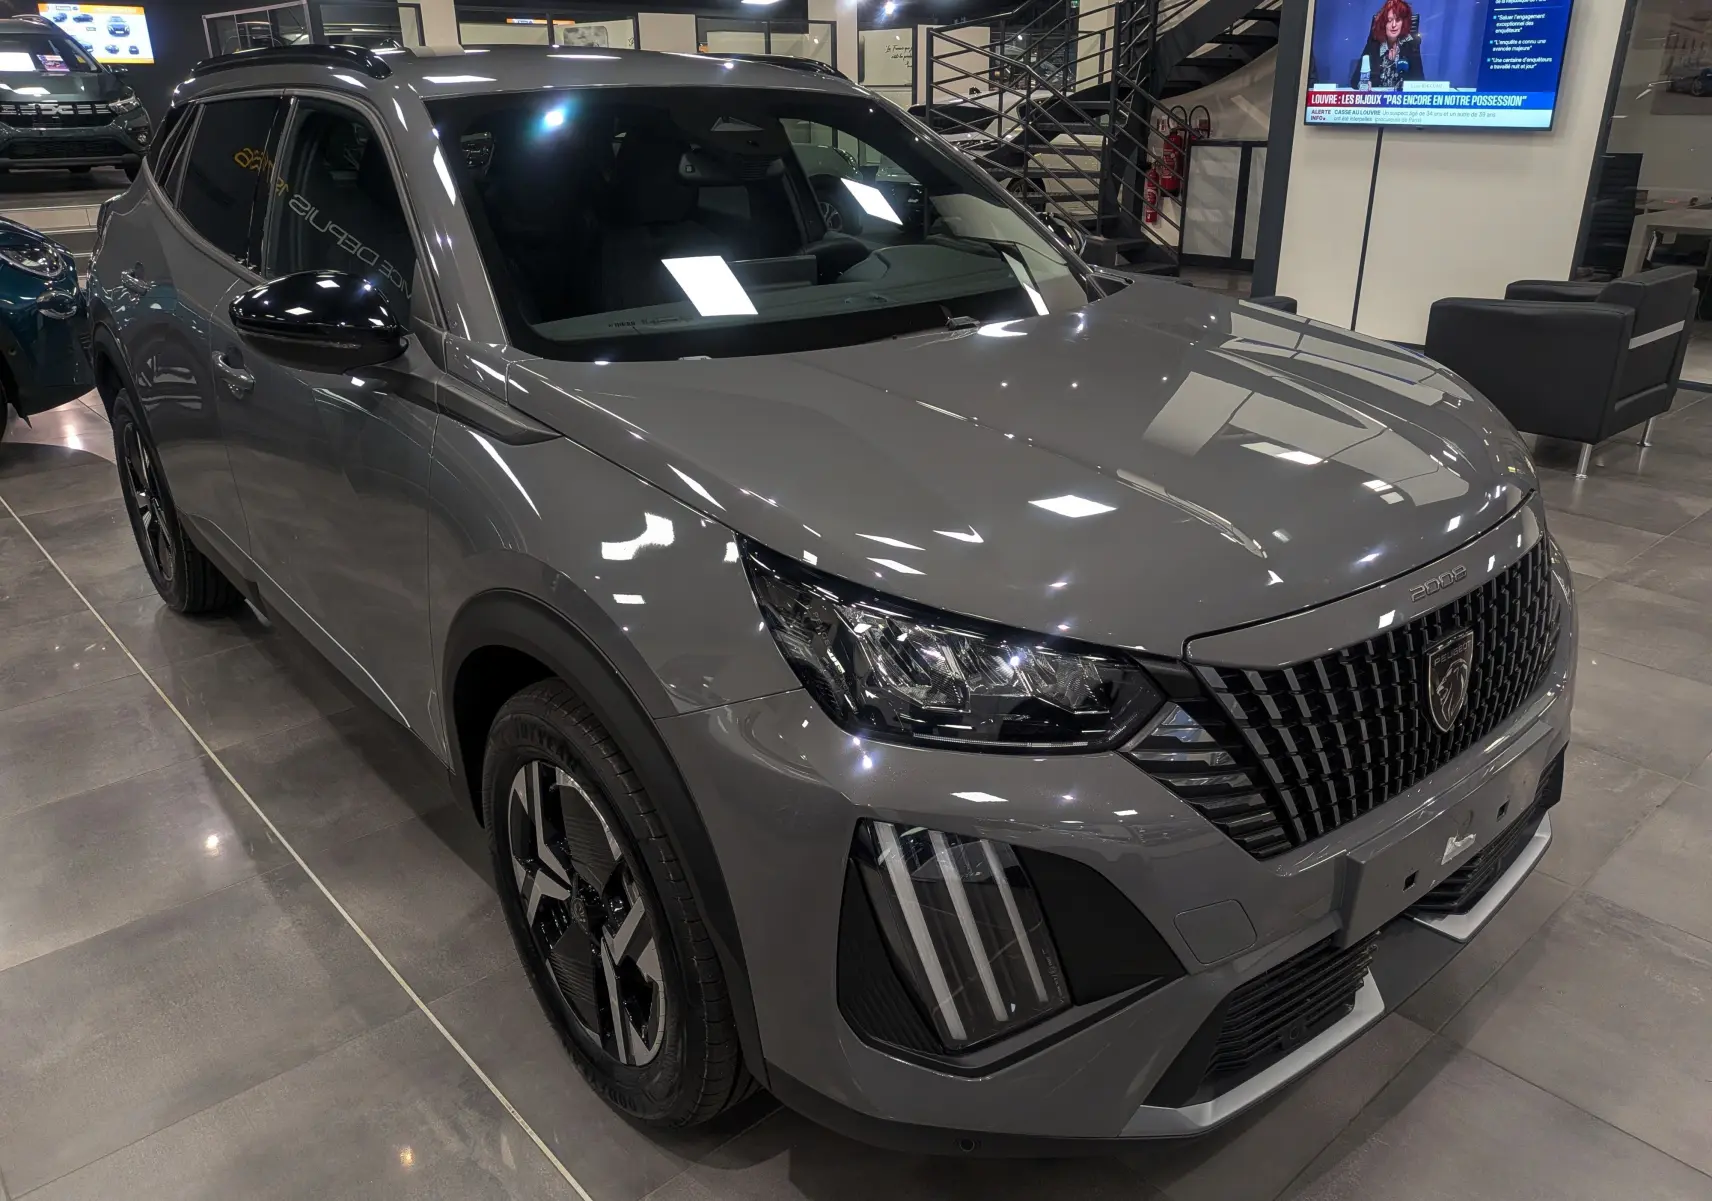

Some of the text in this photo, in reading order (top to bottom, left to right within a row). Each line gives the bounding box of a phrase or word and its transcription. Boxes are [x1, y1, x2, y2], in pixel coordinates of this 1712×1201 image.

[1311, 94, 1338, 105] LOUVRE
[1341, 94, 1355, 105] LES
[1355, 94, 1382, 105] BIJOUX
[1384, 94, 1402, 105] "PAS
[1403, 95, 1432, 105] ENCORE
[1434, 95, 1443, 105] EN
[1444, 95, 1469, 105] NOTRE
[1471, 95, 1527, 106] POSSESSION"
[1409, 564, 1468, 602] 2008
[1433, 640, 1472, 667] PEUGEOT
